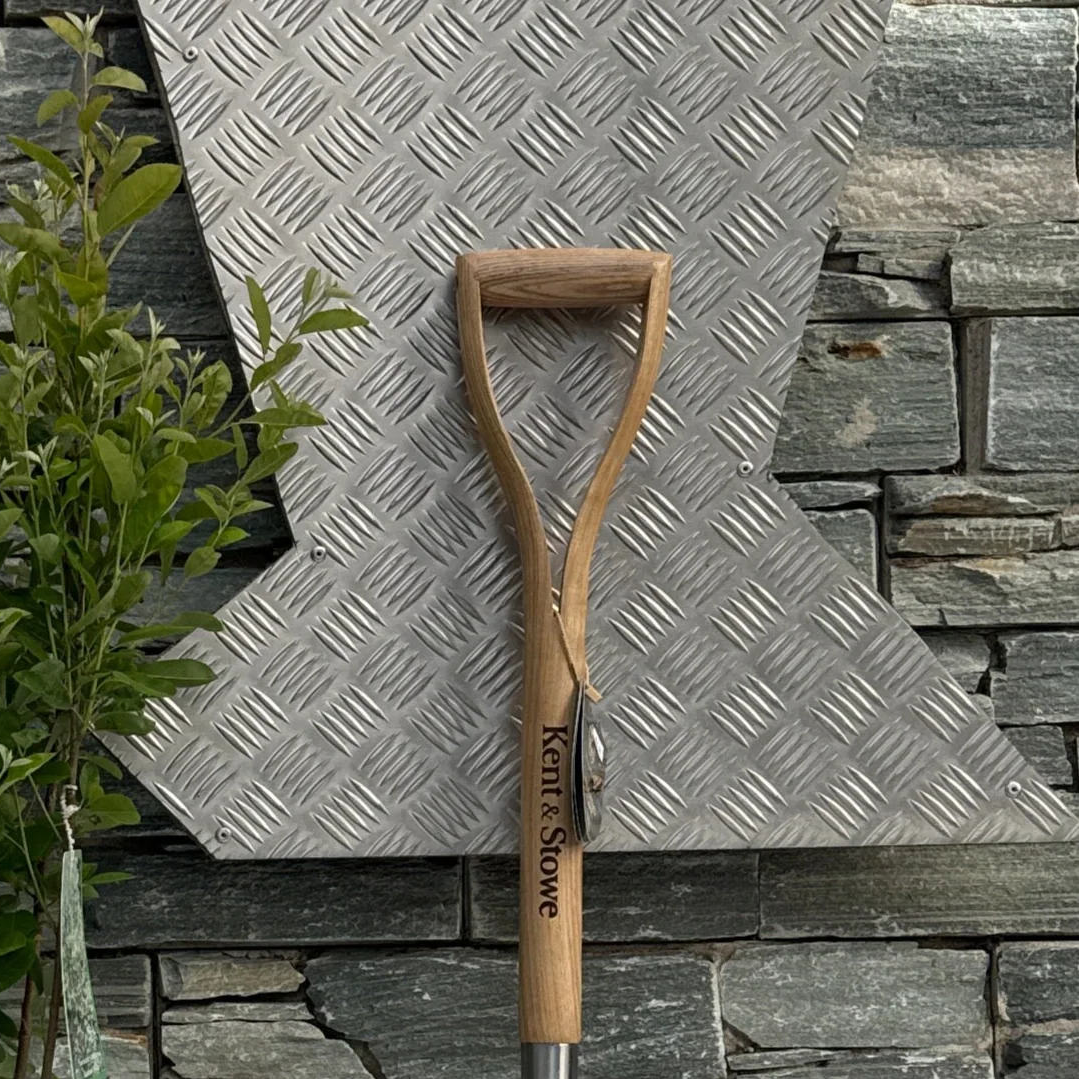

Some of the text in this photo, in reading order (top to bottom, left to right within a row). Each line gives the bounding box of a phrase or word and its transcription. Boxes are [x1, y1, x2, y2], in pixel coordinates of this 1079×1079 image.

[539, 724, 568, 919] Kent & Stowe
